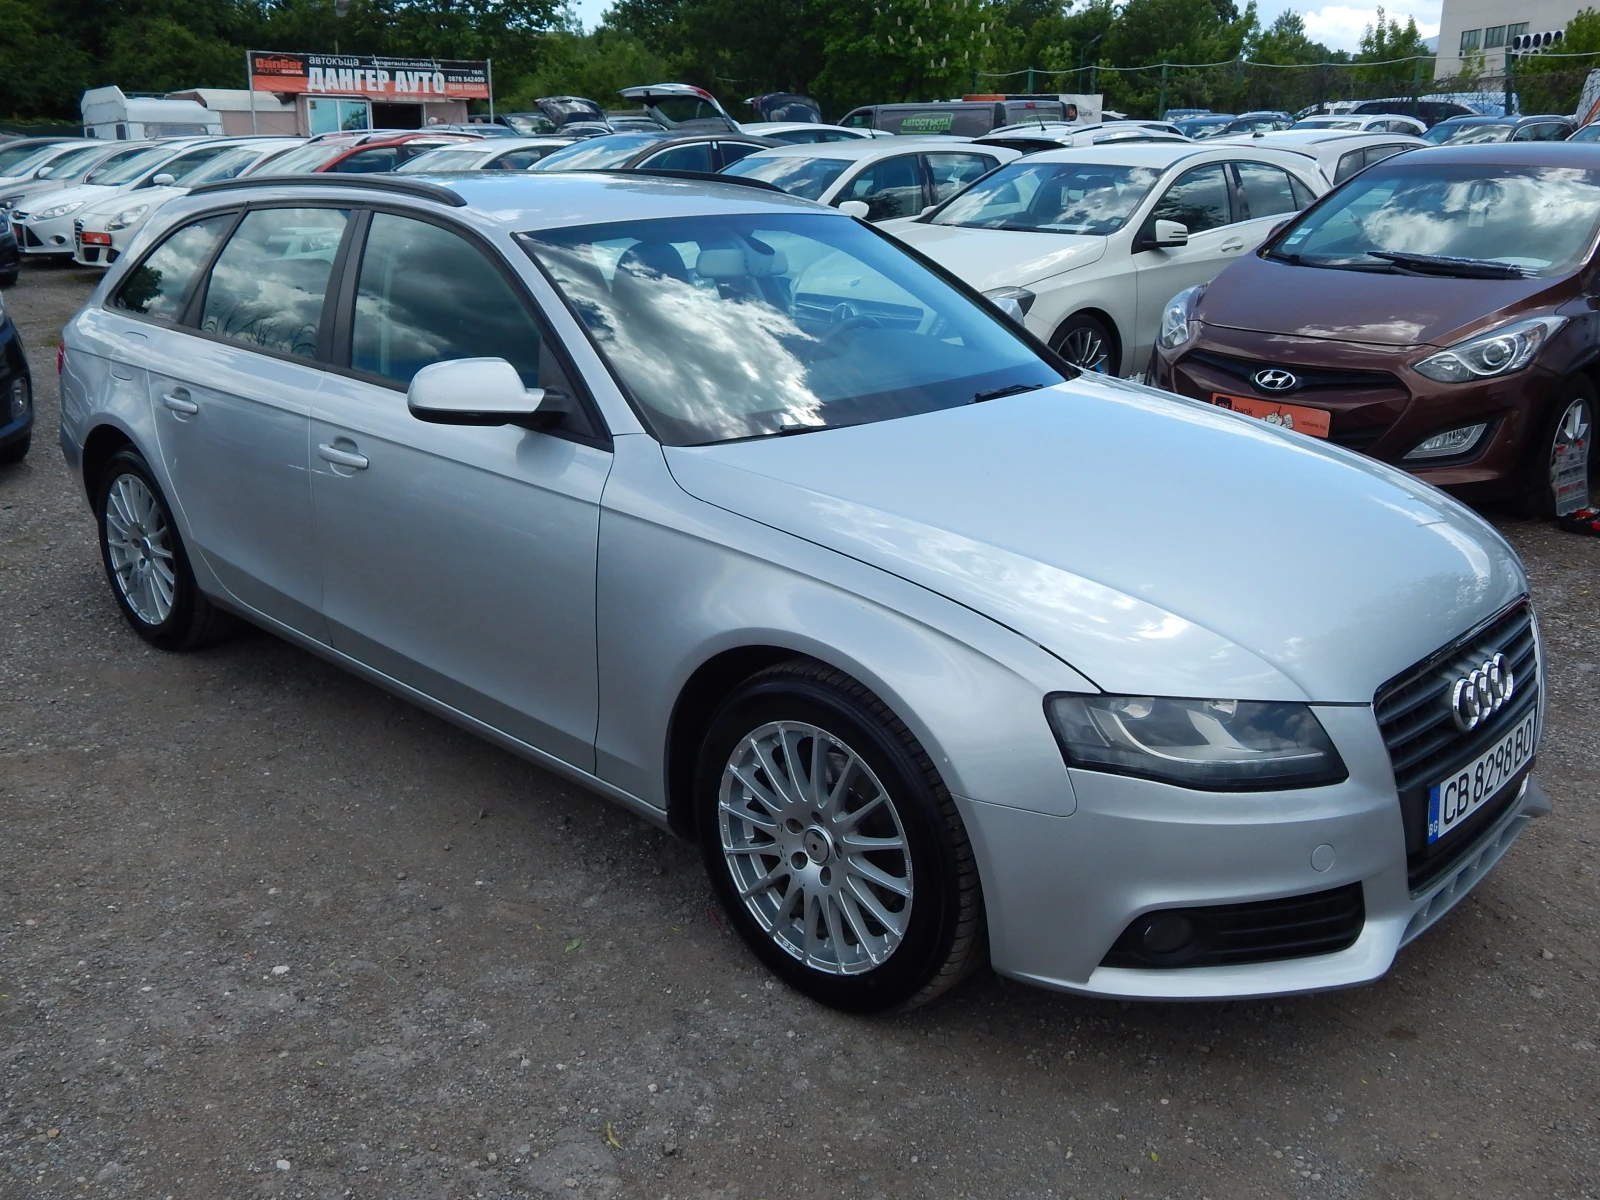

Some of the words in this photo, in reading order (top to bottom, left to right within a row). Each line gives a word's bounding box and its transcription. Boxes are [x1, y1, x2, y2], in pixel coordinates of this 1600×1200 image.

[309, 56, 359, 67] автокъща
[307, 66, 389, 93] ДАНГЕР
[395, 70, 445, 94] АУТО
[1079, 109, 1093, 117] bank
[901, 118, 949, 127] АВТОСТЪКЛА
[1234, 404, 1253, 416] bank
[1473, 737, 1513, 803] 8298
[1428, 820, 1438, 837] BG
